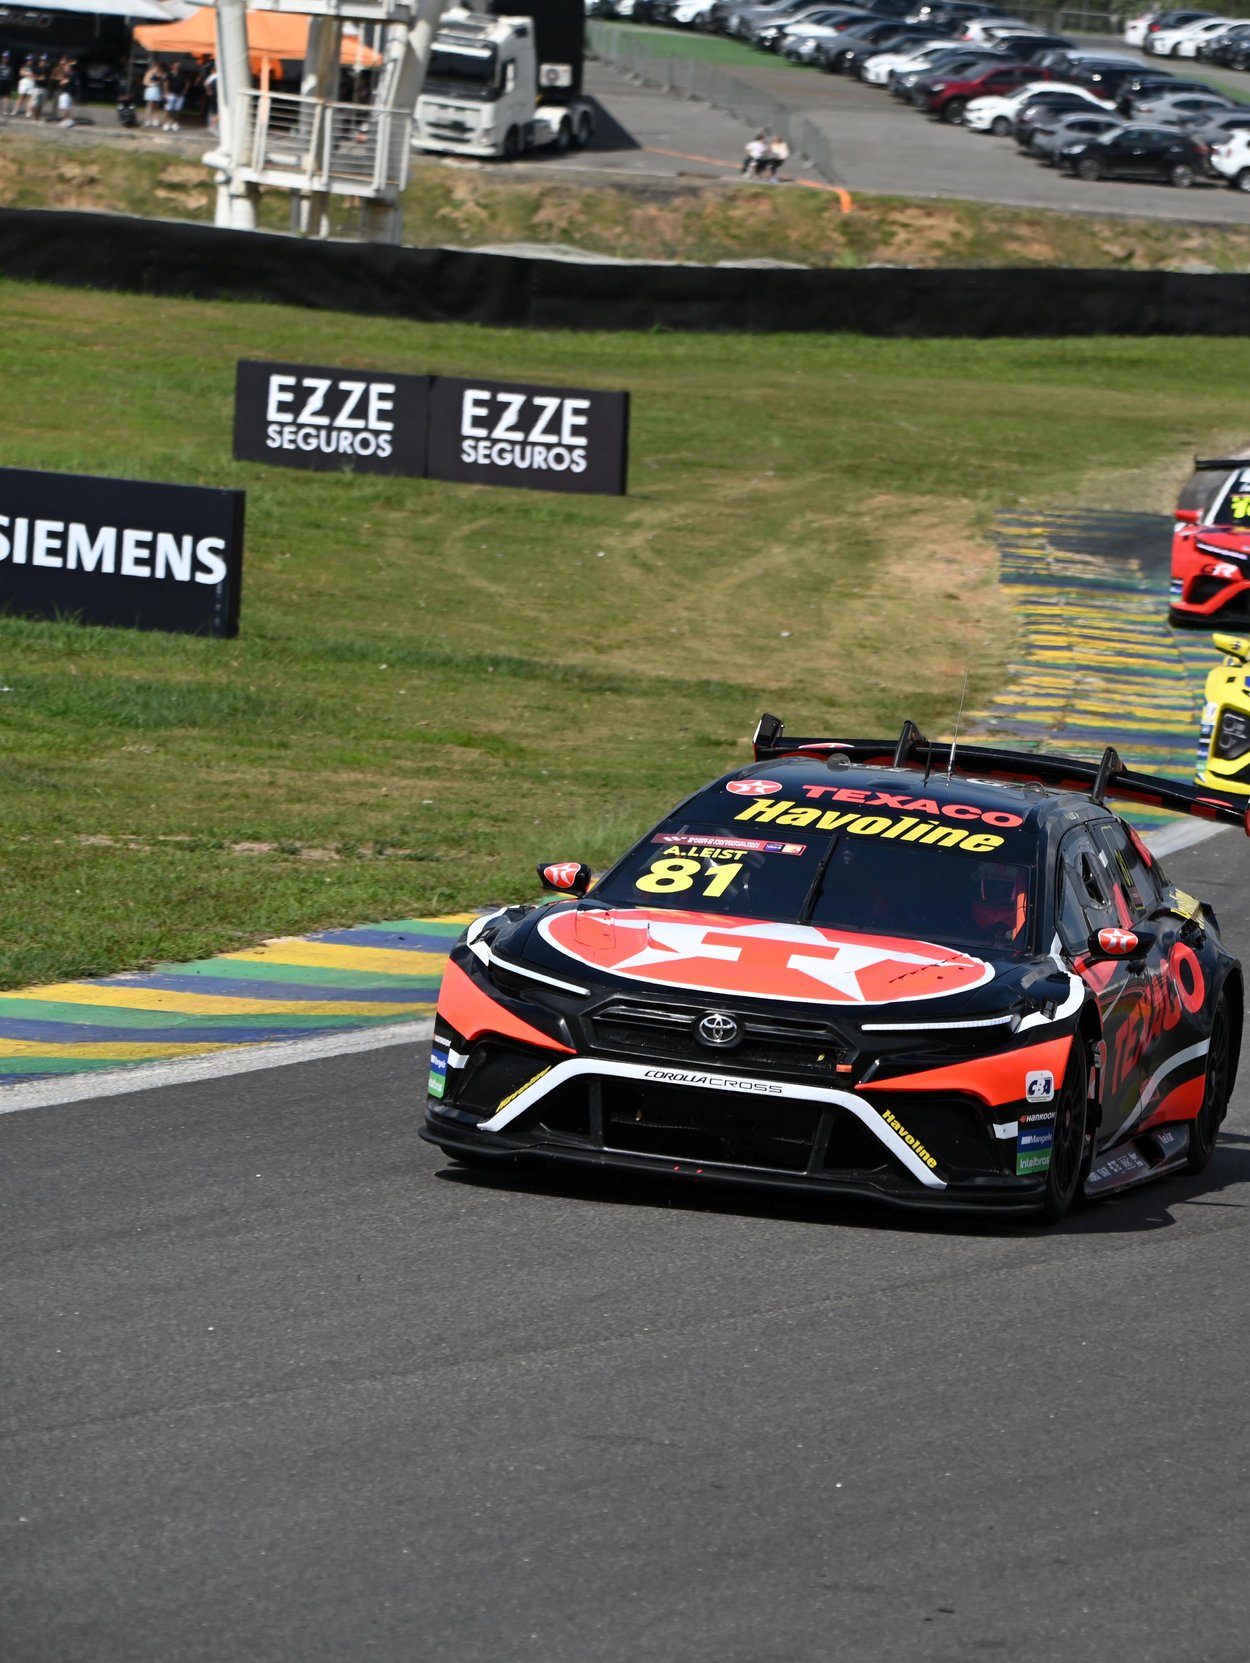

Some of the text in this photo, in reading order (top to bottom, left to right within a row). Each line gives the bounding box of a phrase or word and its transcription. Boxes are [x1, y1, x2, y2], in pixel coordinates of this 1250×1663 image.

[266, 374, 396, 431] EZZE
[461, 388, 592, 446] EZZE
[266, 423, 393, 458] SEGUROS
[461, 438, 588, 473] SEGUROS
[733, 798, 1005, 852] Havoline
[802, 784, 1024, 828] TEXACO
[663, 845, 748, 860] A.LEIST
[635, 858, 743, 897] 81
[644, 1069, 783, 1094] COROLLA CROSS
[1028, 1077, 1052, 1096] CBA
[881, 1108, 938, 1169] Havoline
